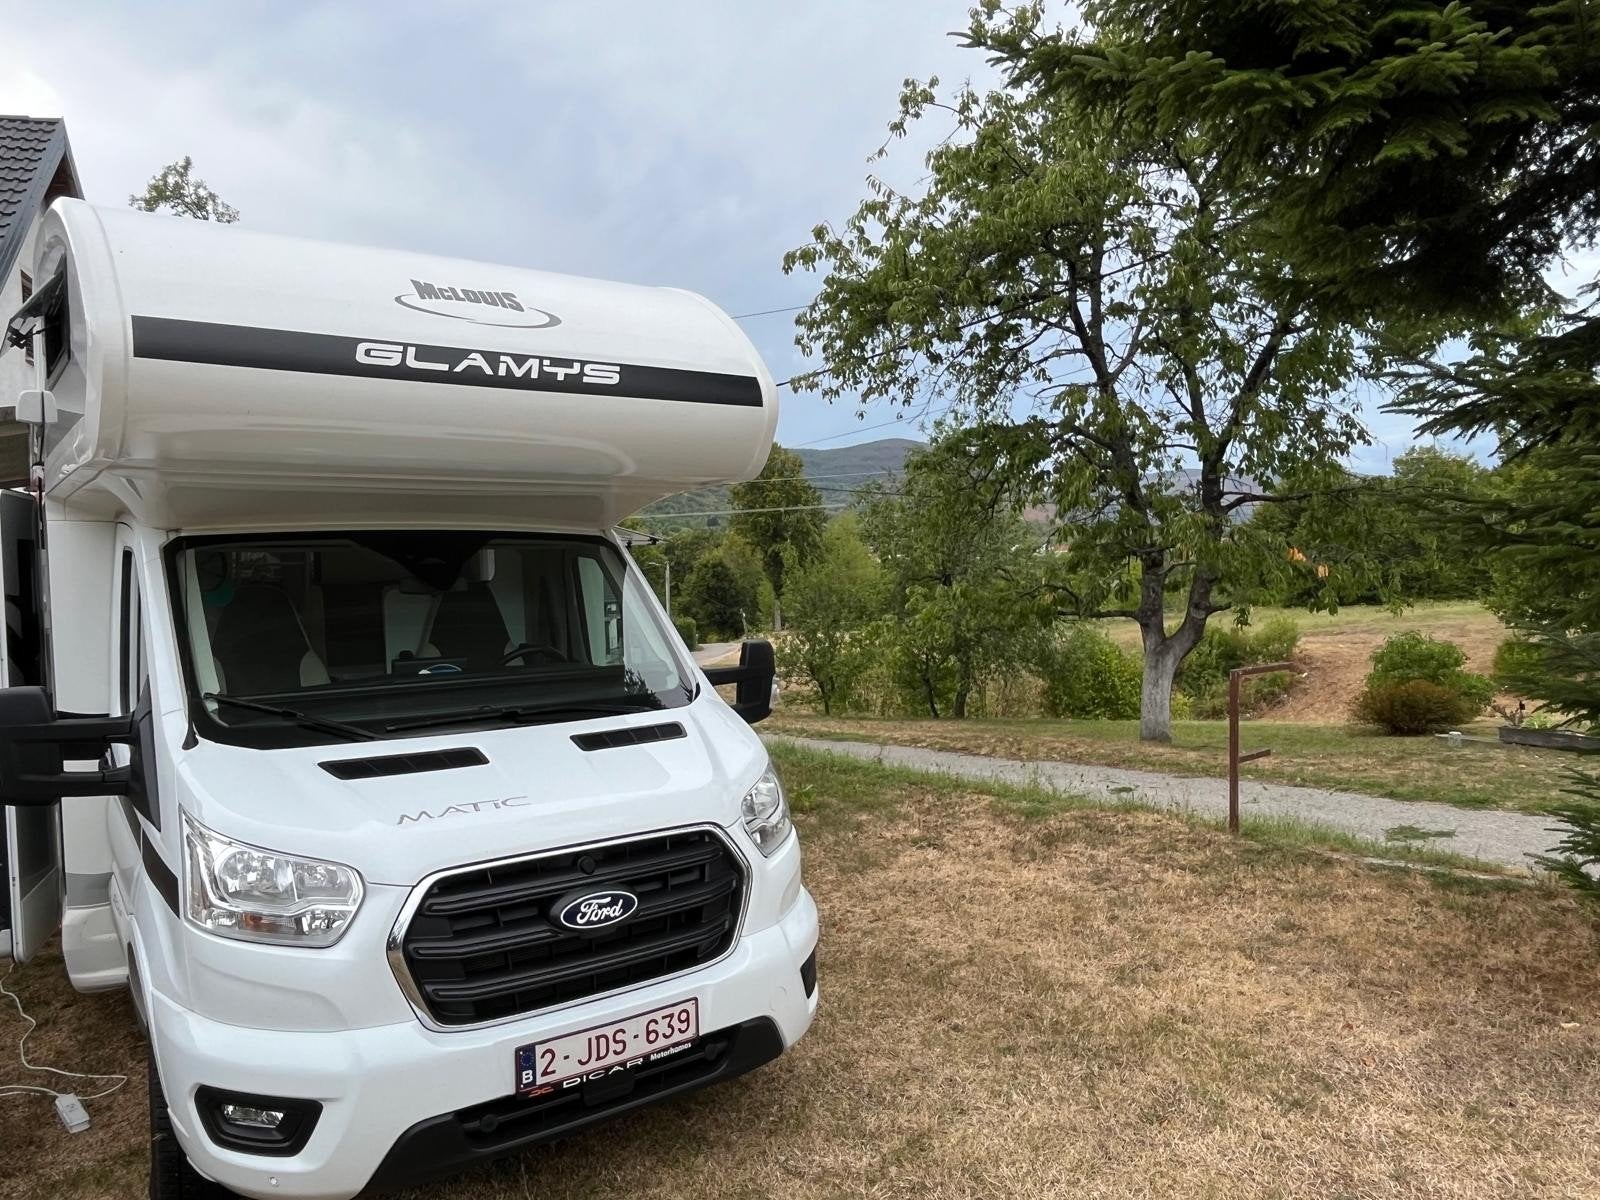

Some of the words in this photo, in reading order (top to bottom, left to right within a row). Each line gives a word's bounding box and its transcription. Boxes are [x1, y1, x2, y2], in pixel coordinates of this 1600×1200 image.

[355, 342, 621, 385] GLAMYS
[397, 796, 531, 825] MATIC
[576, 897, 623, 924] Ford
[522, 1069, 534, 1084] B
[562, 1057, 643, 1089] DICAR
[650, 1042, 692, 1061] Motorhomes
